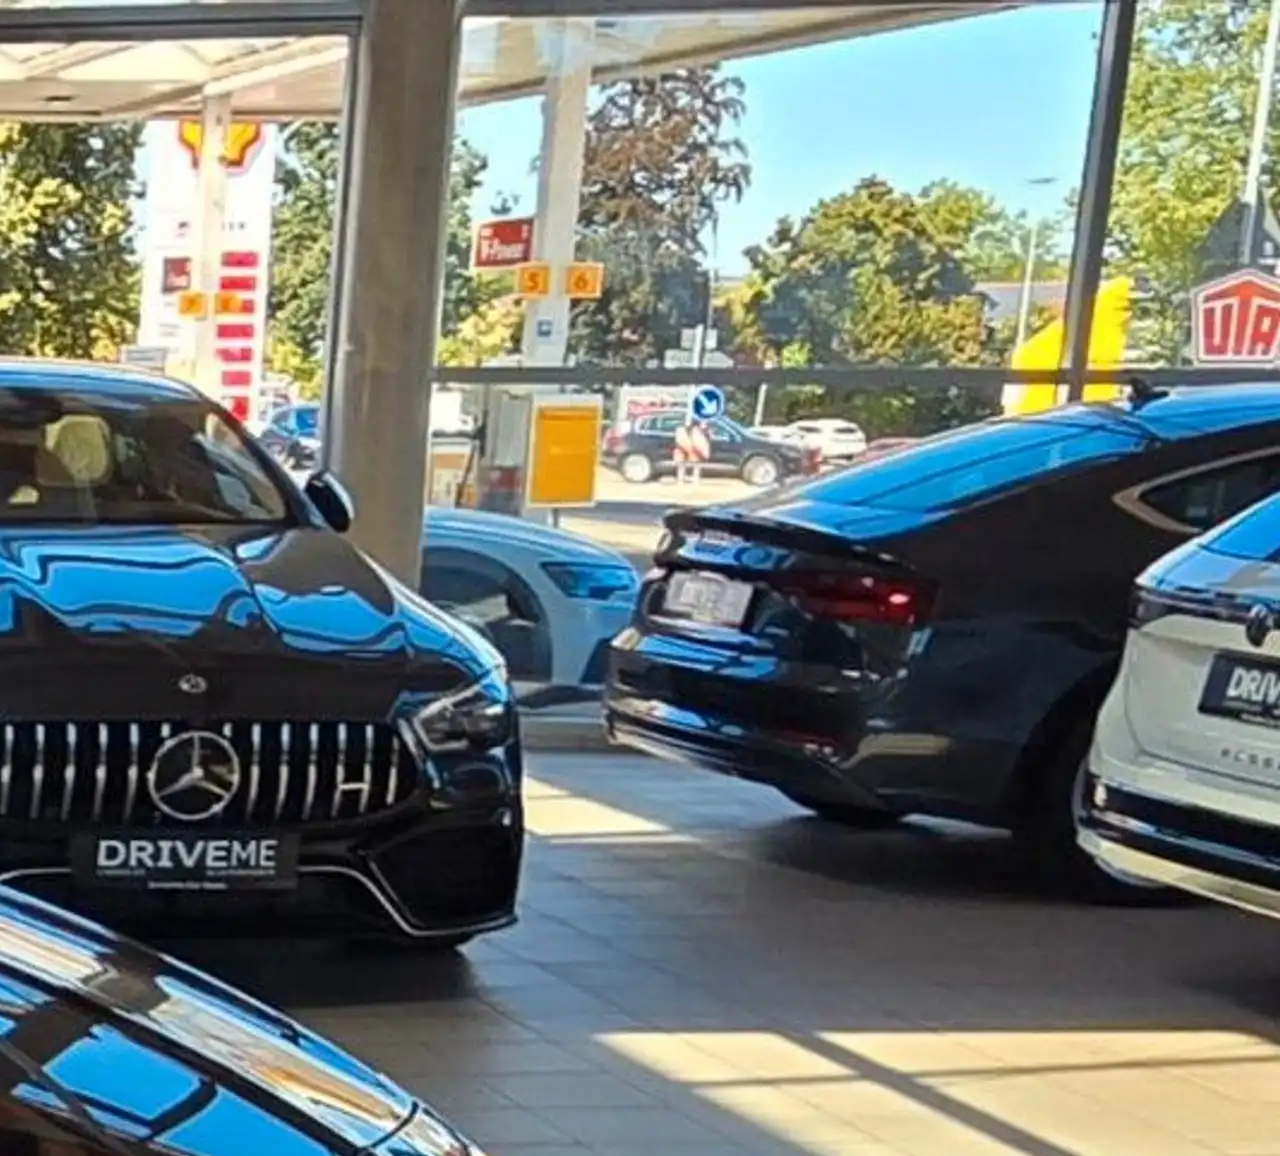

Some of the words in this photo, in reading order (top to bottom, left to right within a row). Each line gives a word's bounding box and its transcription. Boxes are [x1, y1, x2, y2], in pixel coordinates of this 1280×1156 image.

[526, 270, 541, 291] 5
[573, 271, 589, 291] 6
[96, 839, 279, 868] DRIVEME
